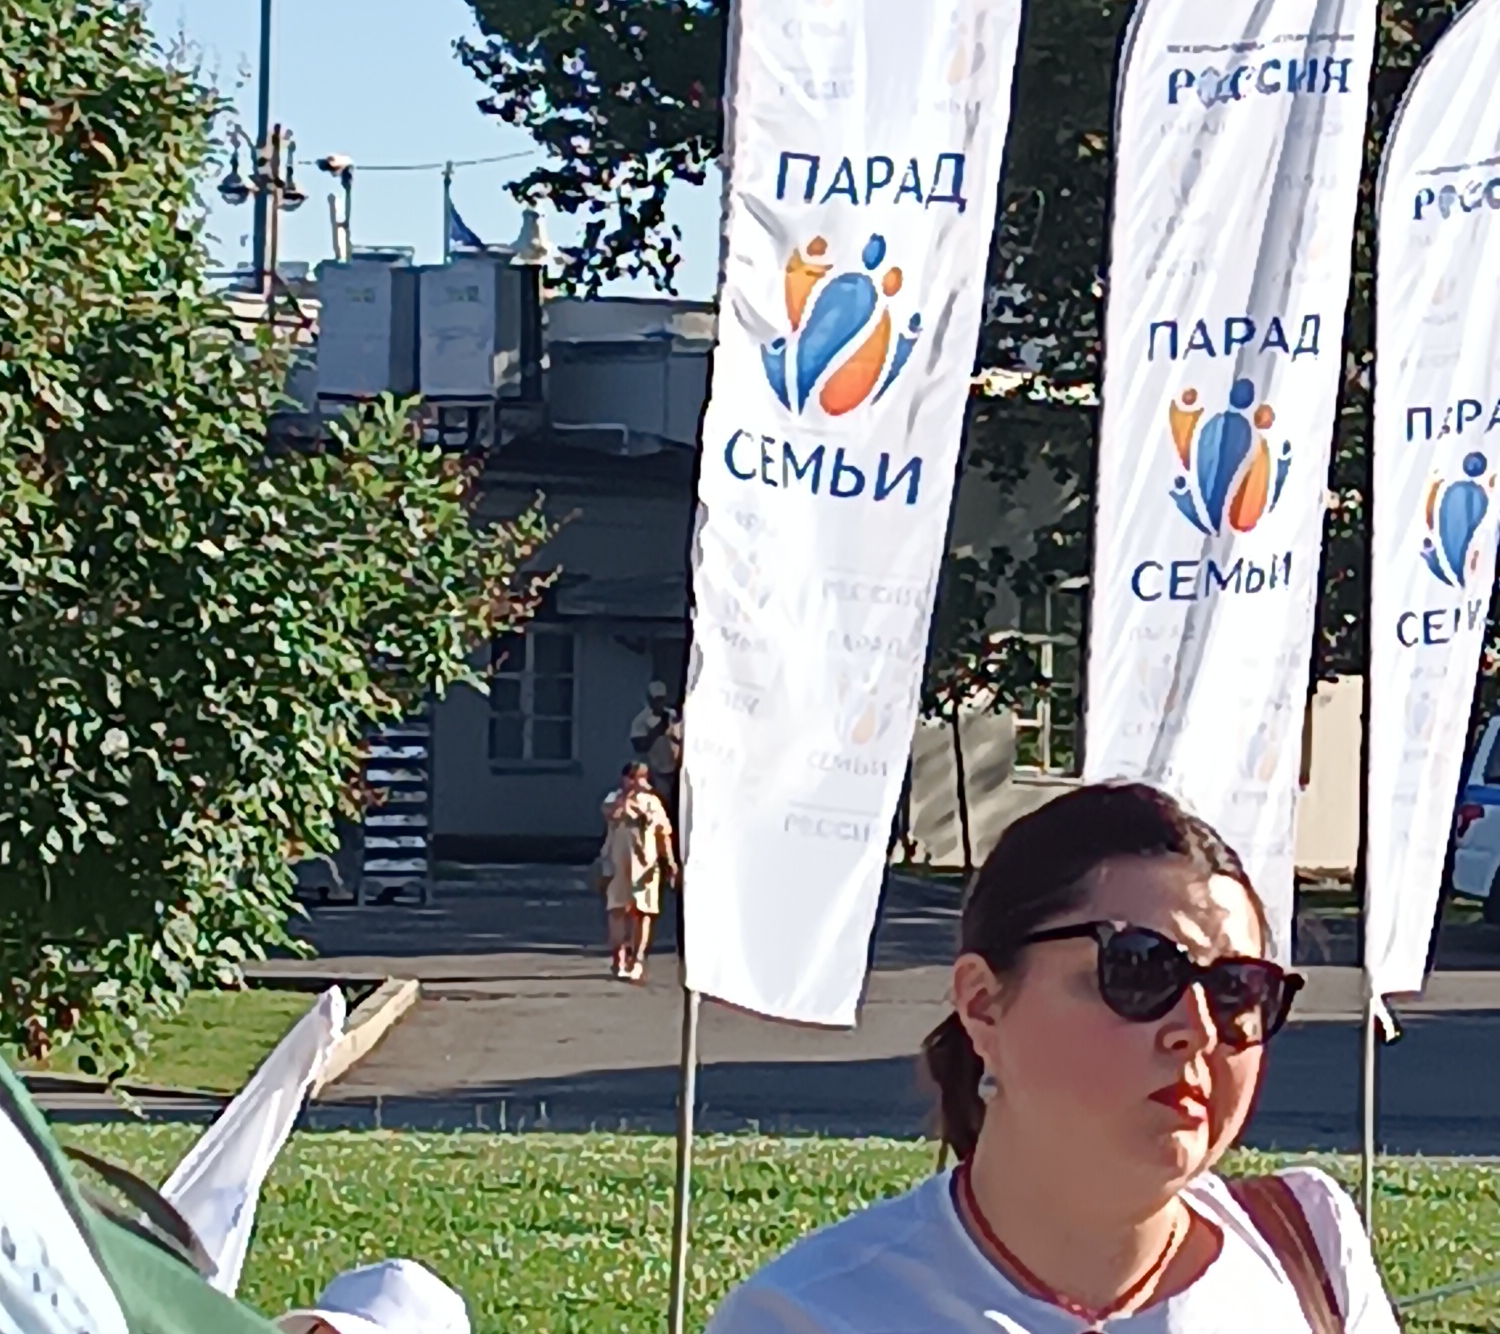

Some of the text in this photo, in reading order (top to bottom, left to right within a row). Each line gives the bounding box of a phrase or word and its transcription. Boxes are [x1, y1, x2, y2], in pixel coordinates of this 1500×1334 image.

[1168, 55, 1353, 109] РОССИЯ
[776, 152, 967, 215] ПАРАД
[1148, 313, 1321, 362] ПАРАД
[724, 429, 924, 506] СЕМЬИ
[1131, 552, 1292, 602] СЕМЬИ
